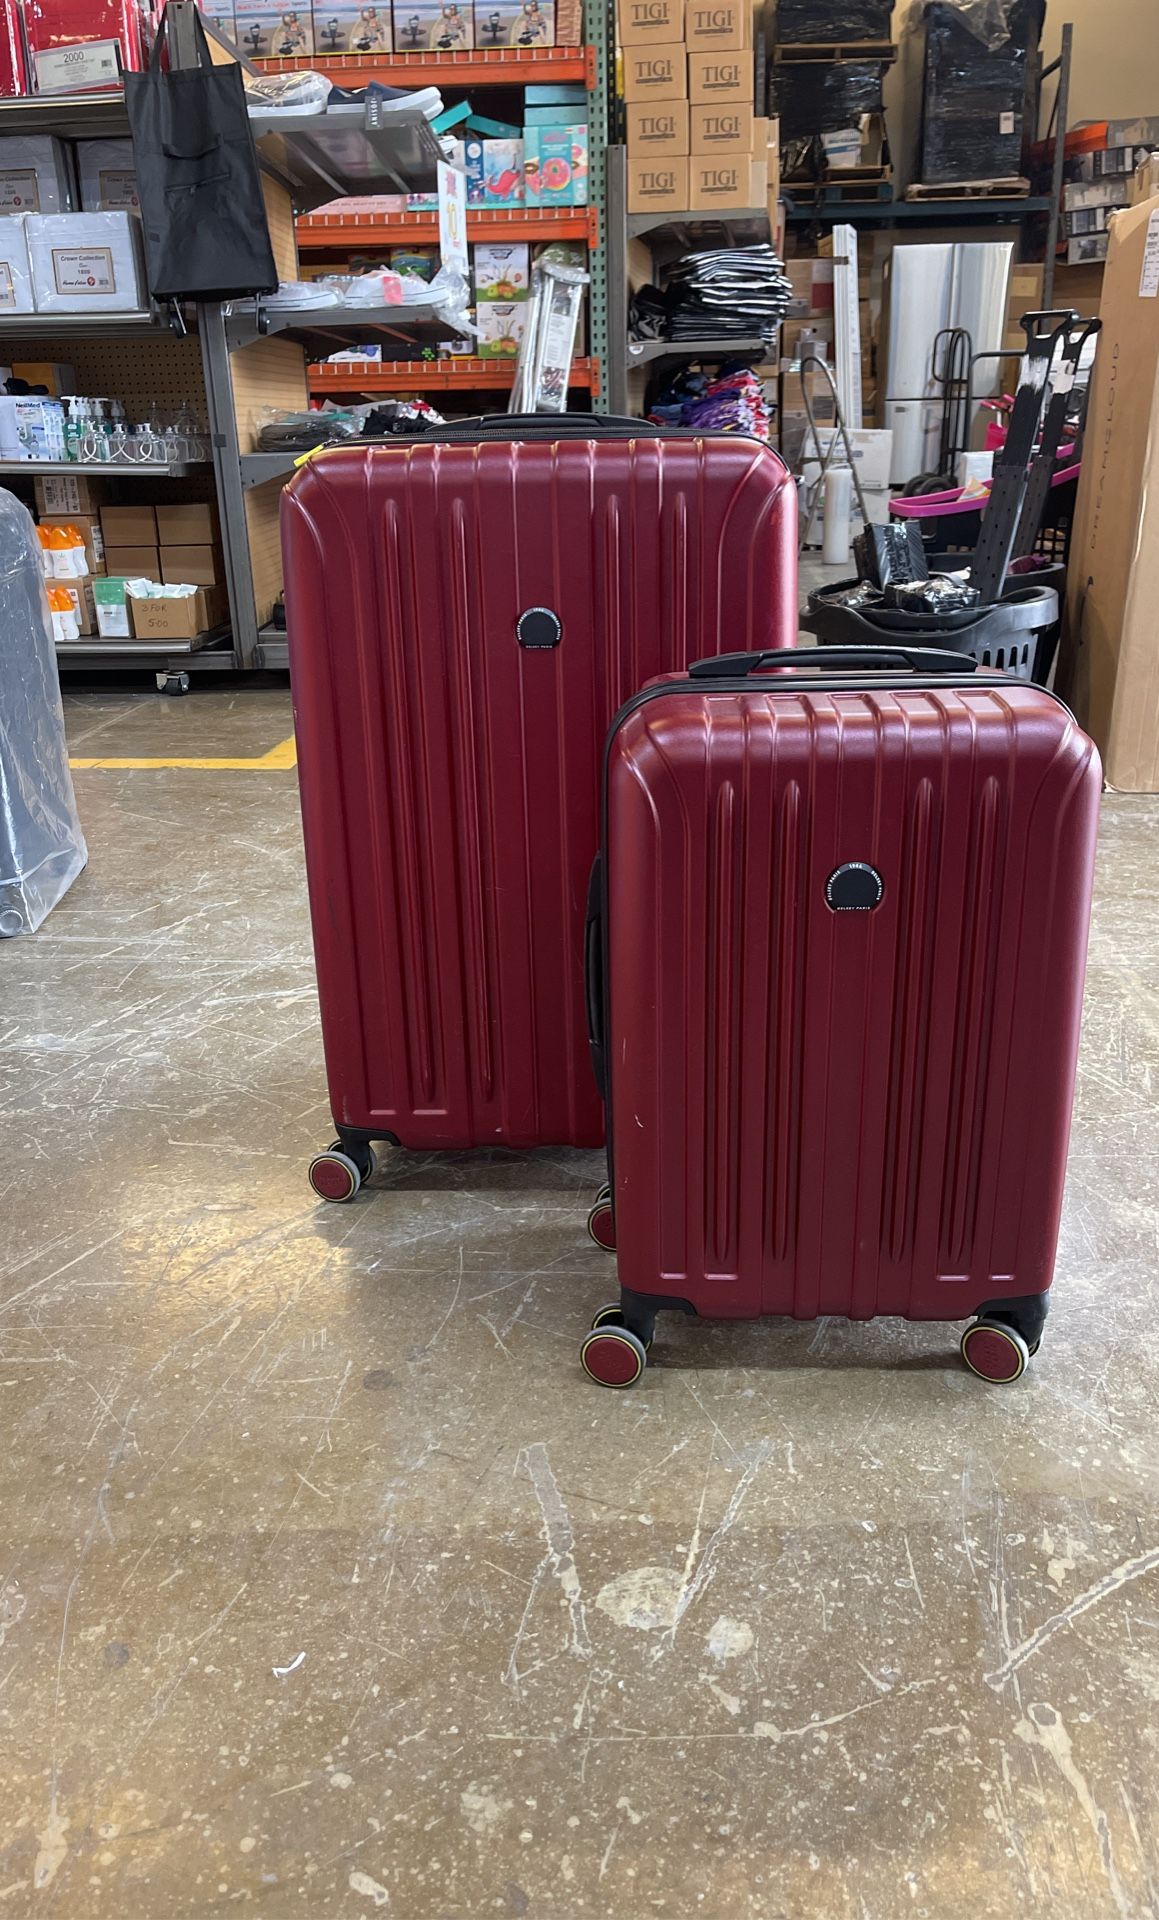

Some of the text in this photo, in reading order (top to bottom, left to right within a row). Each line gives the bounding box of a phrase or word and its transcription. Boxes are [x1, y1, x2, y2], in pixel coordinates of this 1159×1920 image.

[632, 2, 669, 20] TIGI
[694, 10, 733, 28] TIGI
[63, 51, 84, 63] 2000
[635, 59, 672, 77] TIGI
[702, 65, 739, 82] TIGI
[638, 116, 675, 134] TIGI
[703, 116, 740, 133] TIGI
[638, 172, 675, 188] TIGI
[700, 169, 737, 186] TIGI
[142, 603, 167, 612] 3 FOR
